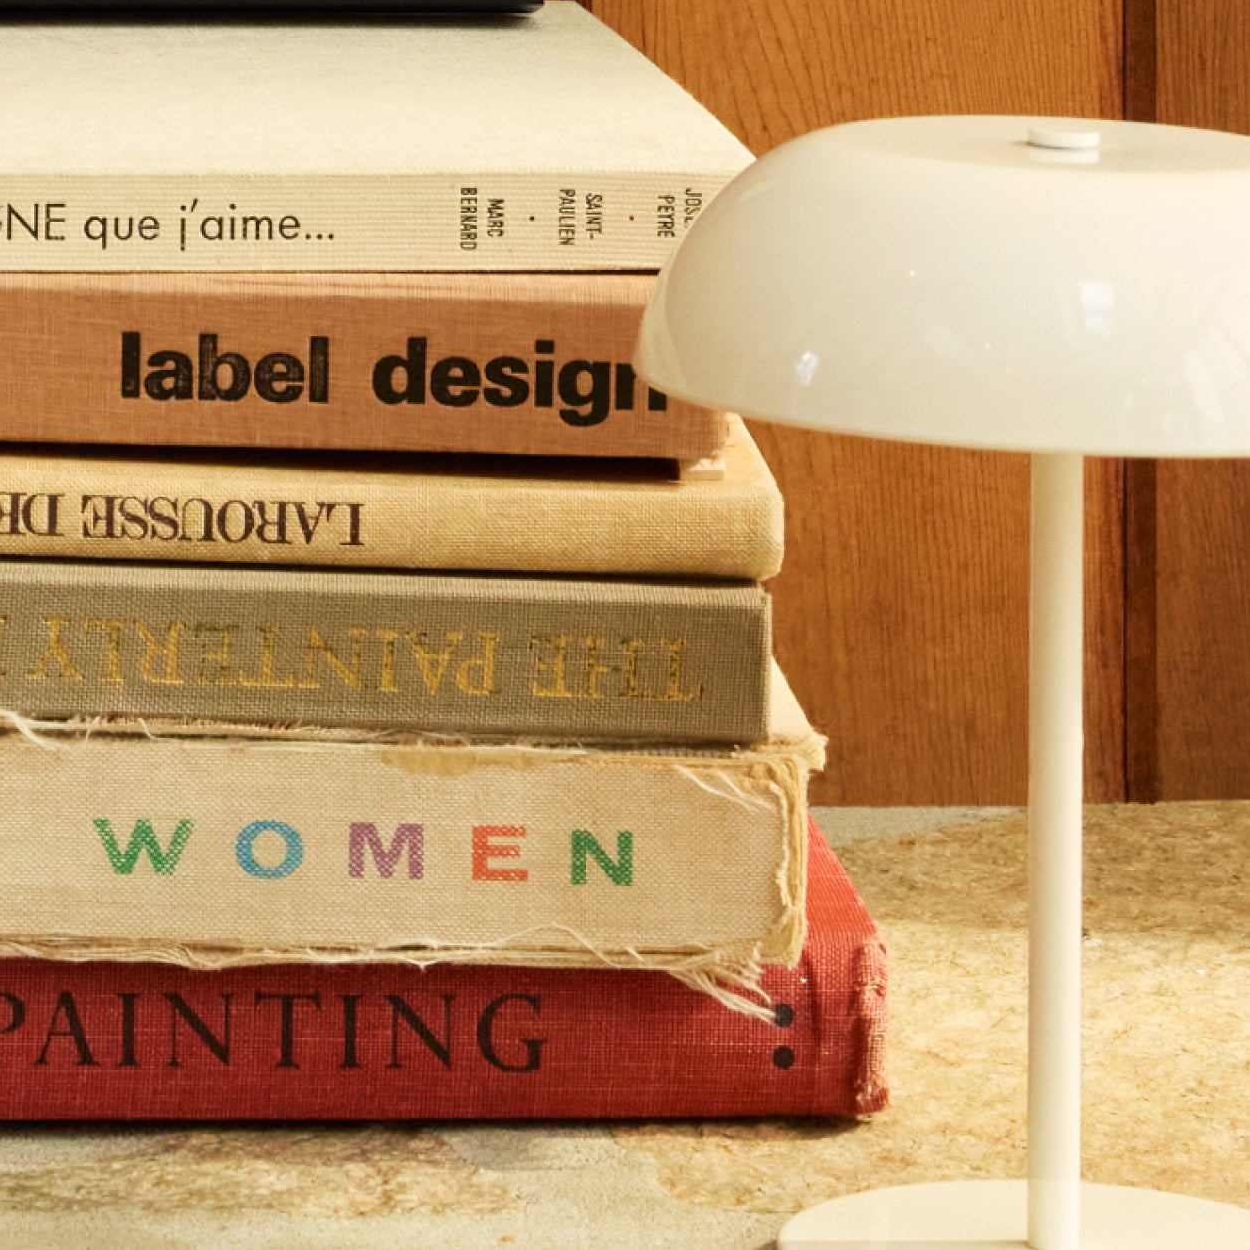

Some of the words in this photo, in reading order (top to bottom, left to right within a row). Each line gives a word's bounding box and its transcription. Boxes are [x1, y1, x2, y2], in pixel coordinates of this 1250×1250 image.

[83, 216, 160, 250] que
[180, 198, 335, 252] j'aime...
[460, 187, 478, 251] BERNARD
[487, 198, 505, 238] MARC
[558, 188, 576, 246] PAULIEN
[121, 331, 330, 403] label
[81, 494, 366, 547] LAROUSSE
[26, 616, 500, 695] PAINTERLY
[529, 633, 704, 701] THE
[93, 816, 634, 888] WOMEN
